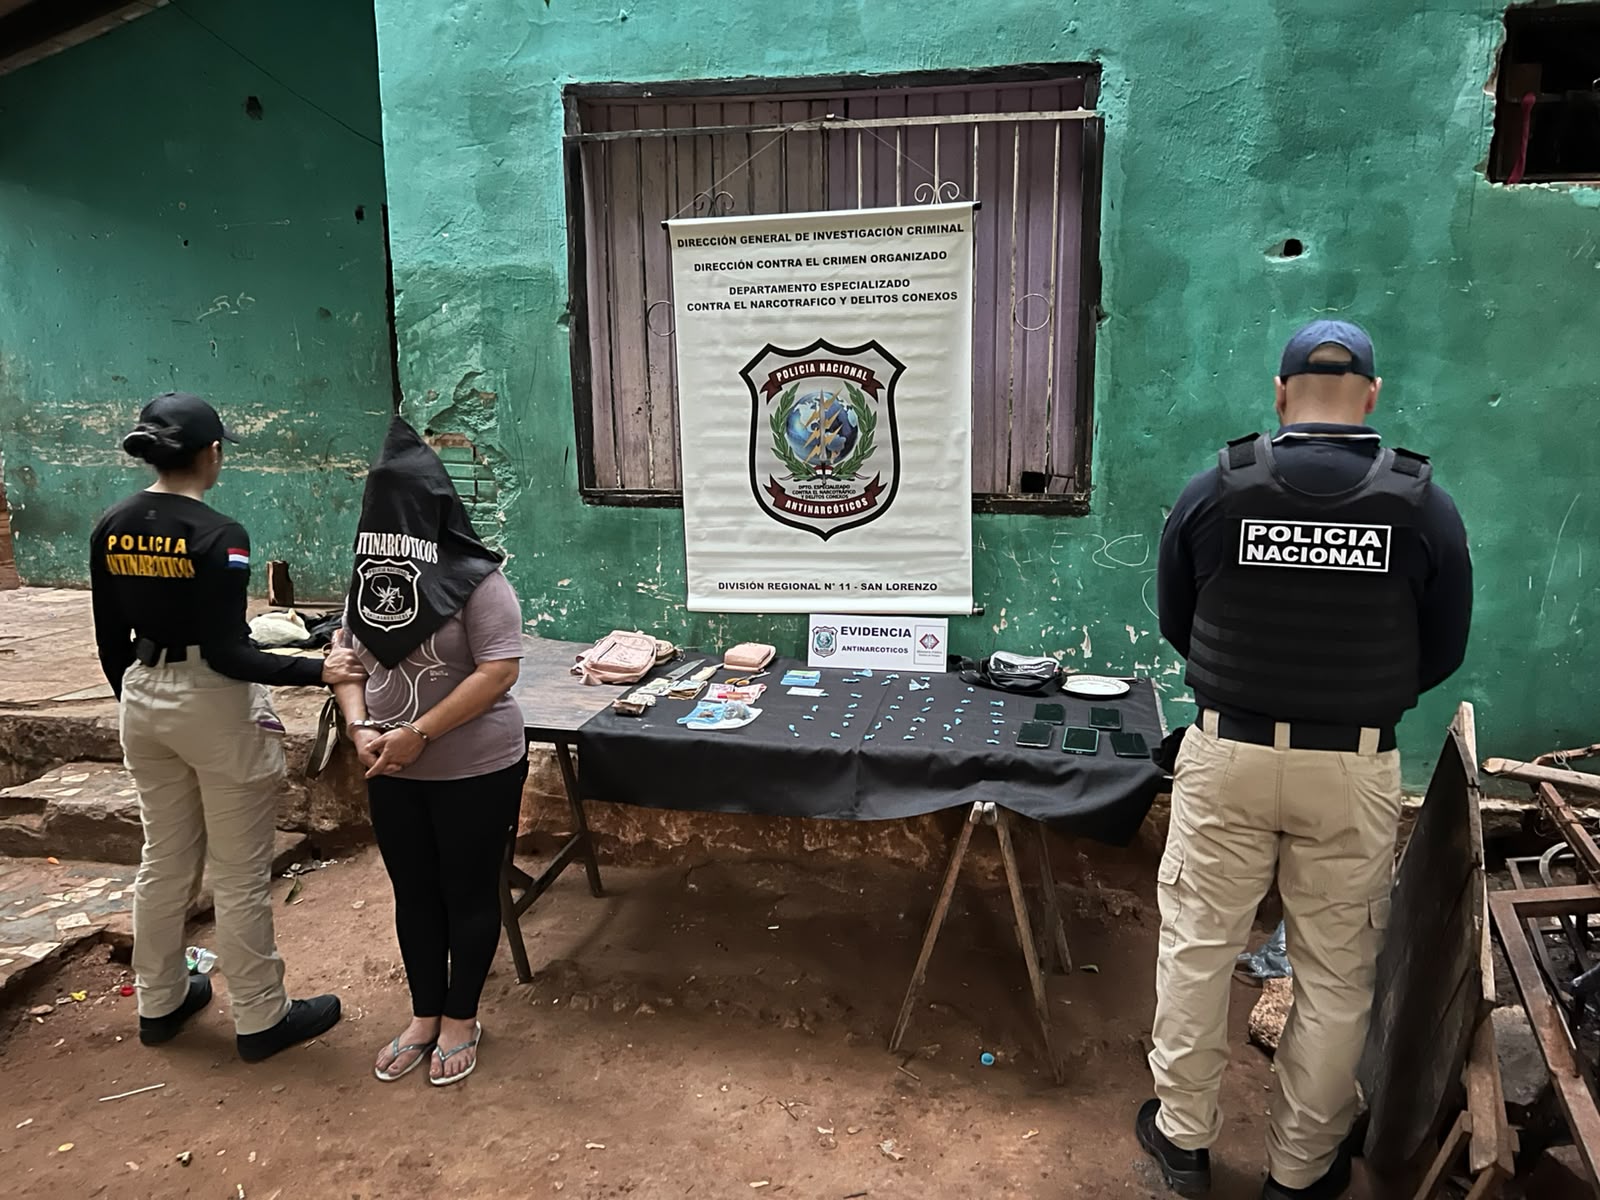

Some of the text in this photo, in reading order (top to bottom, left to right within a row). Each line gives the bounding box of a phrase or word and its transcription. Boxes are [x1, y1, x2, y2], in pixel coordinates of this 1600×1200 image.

[677, 223, 965, 248] DIRECCIÓN GENERAL DE INVESTIGACIÓN CRIMINAL
[694, 250, 947, 272] DIRECCIÓN CONTRA EL CRIMEN ORGANIZADO
[729, 279, 911, 296] DEPARTAMENTO ESPECIALIZADO
[686, 291, 958, 312] CONTRA EL NARCOTRAFICO Y DELITOS CONEXOS
[776, 362, 868, 382] POLICIA NACIONAL
[108, 534, 187, 555] POLICIA
[1247, 525, 1383, 549] POLICIA
[1246, 543, 1382, 567] NACIONAL
[718, 581, 764, 591] DIVISIÓN
[768, 582, 822, 591] REGIONAL
[839, 582, 851, 591] 11
[860, 582, 883, 591] SAN
[886, 582, 938, 591] LORENZO
[840, 626, 912, 638] EVIDENCIA
[841, 645, 909, 654] ANTINARCOTICOS
